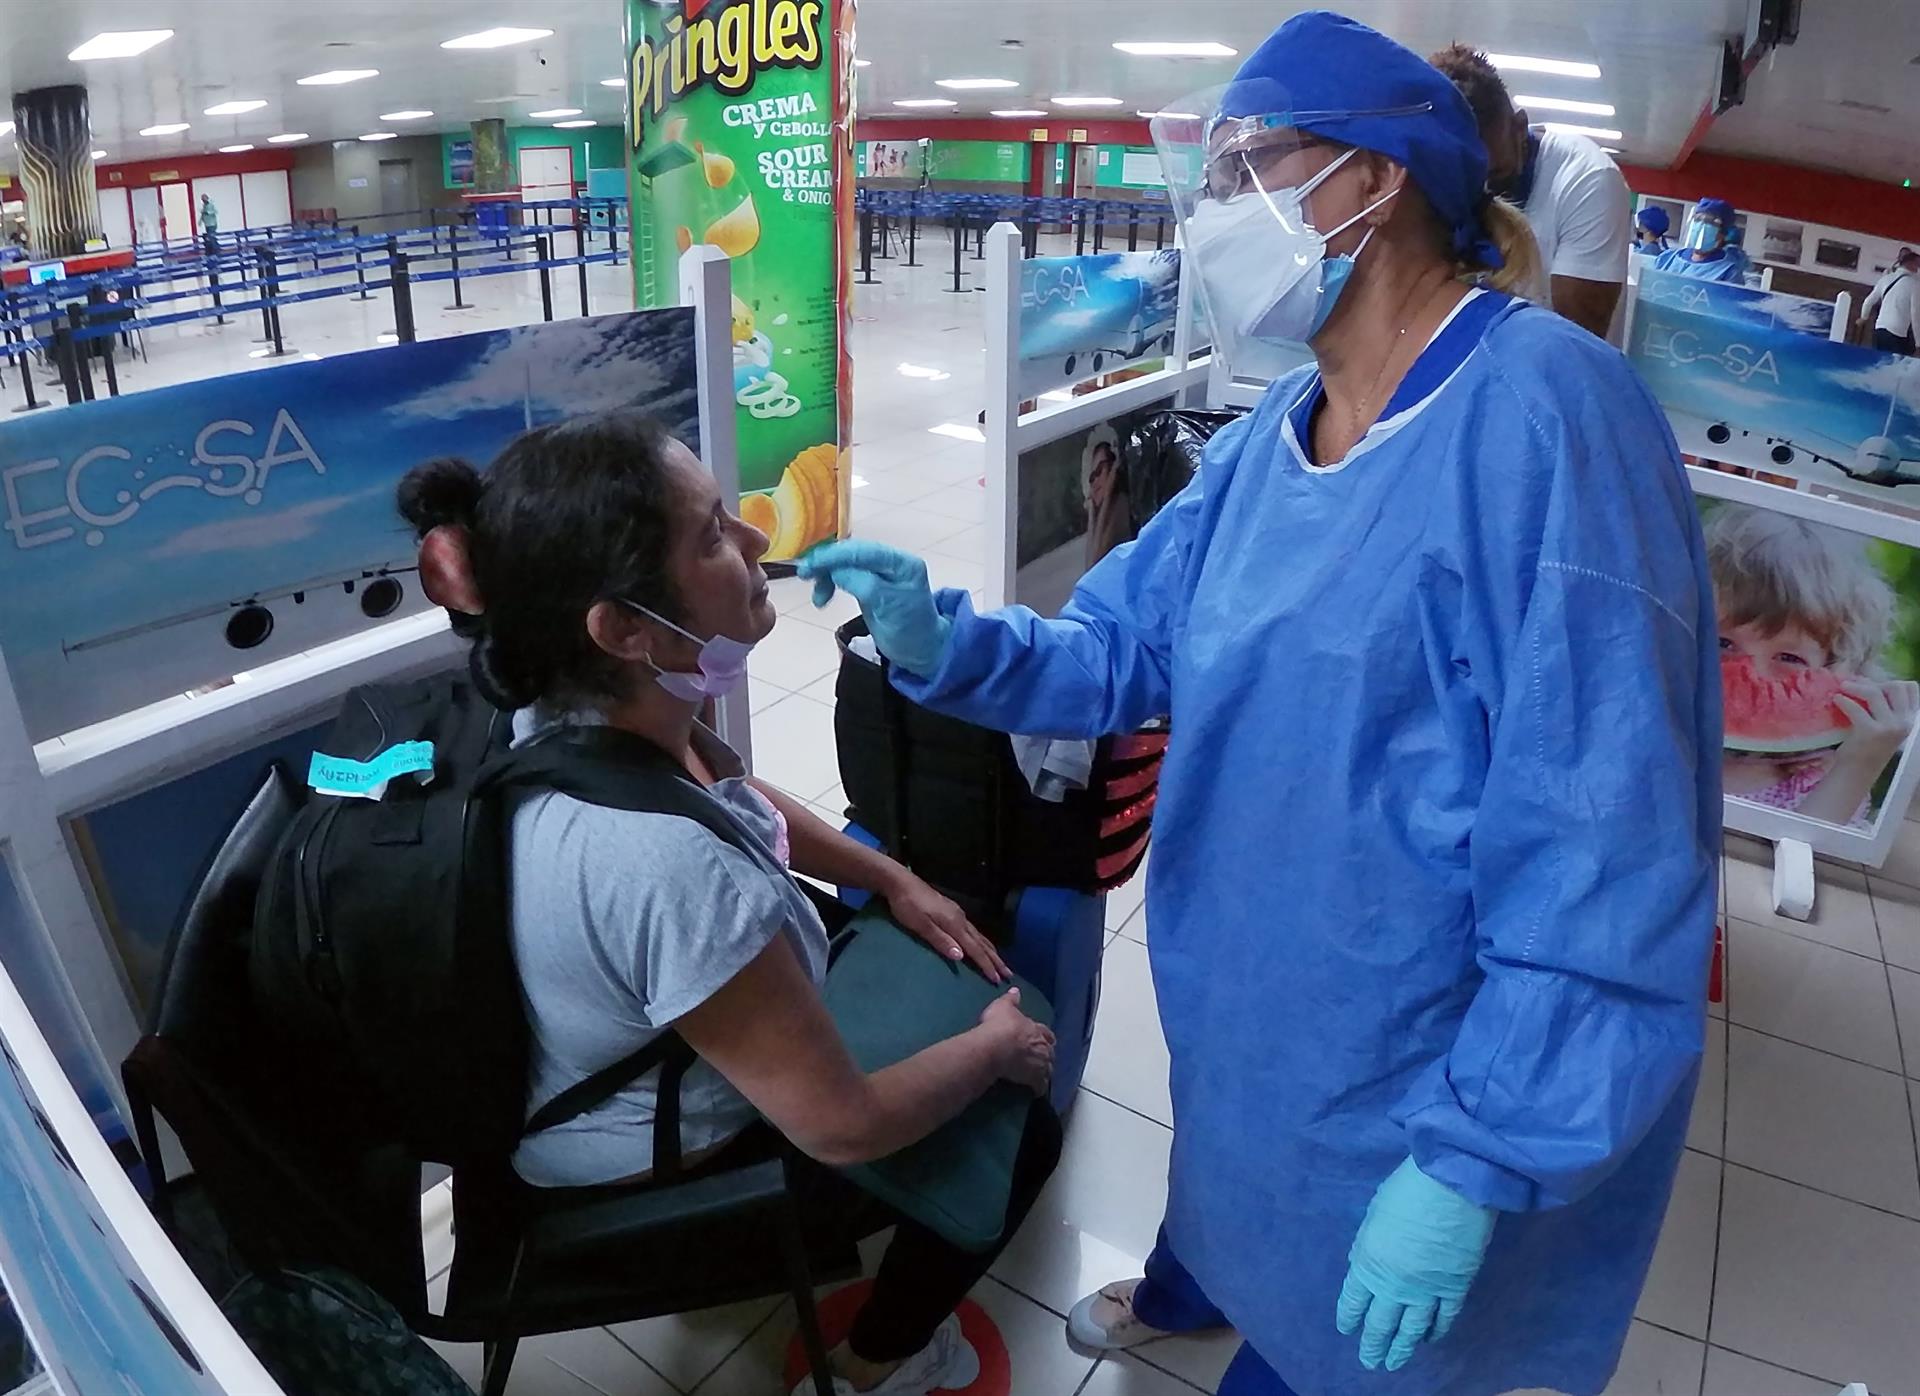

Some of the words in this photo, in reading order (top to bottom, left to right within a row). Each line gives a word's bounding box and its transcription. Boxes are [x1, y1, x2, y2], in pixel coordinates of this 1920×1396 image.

[631, 0, 820, 149] Pringles
[722, 92, 817, 127] CREMA
[757, 143, 828, 174] SOUR
[782, 187, 794, 202] &
[797, 189, 832, 205] ONIO
